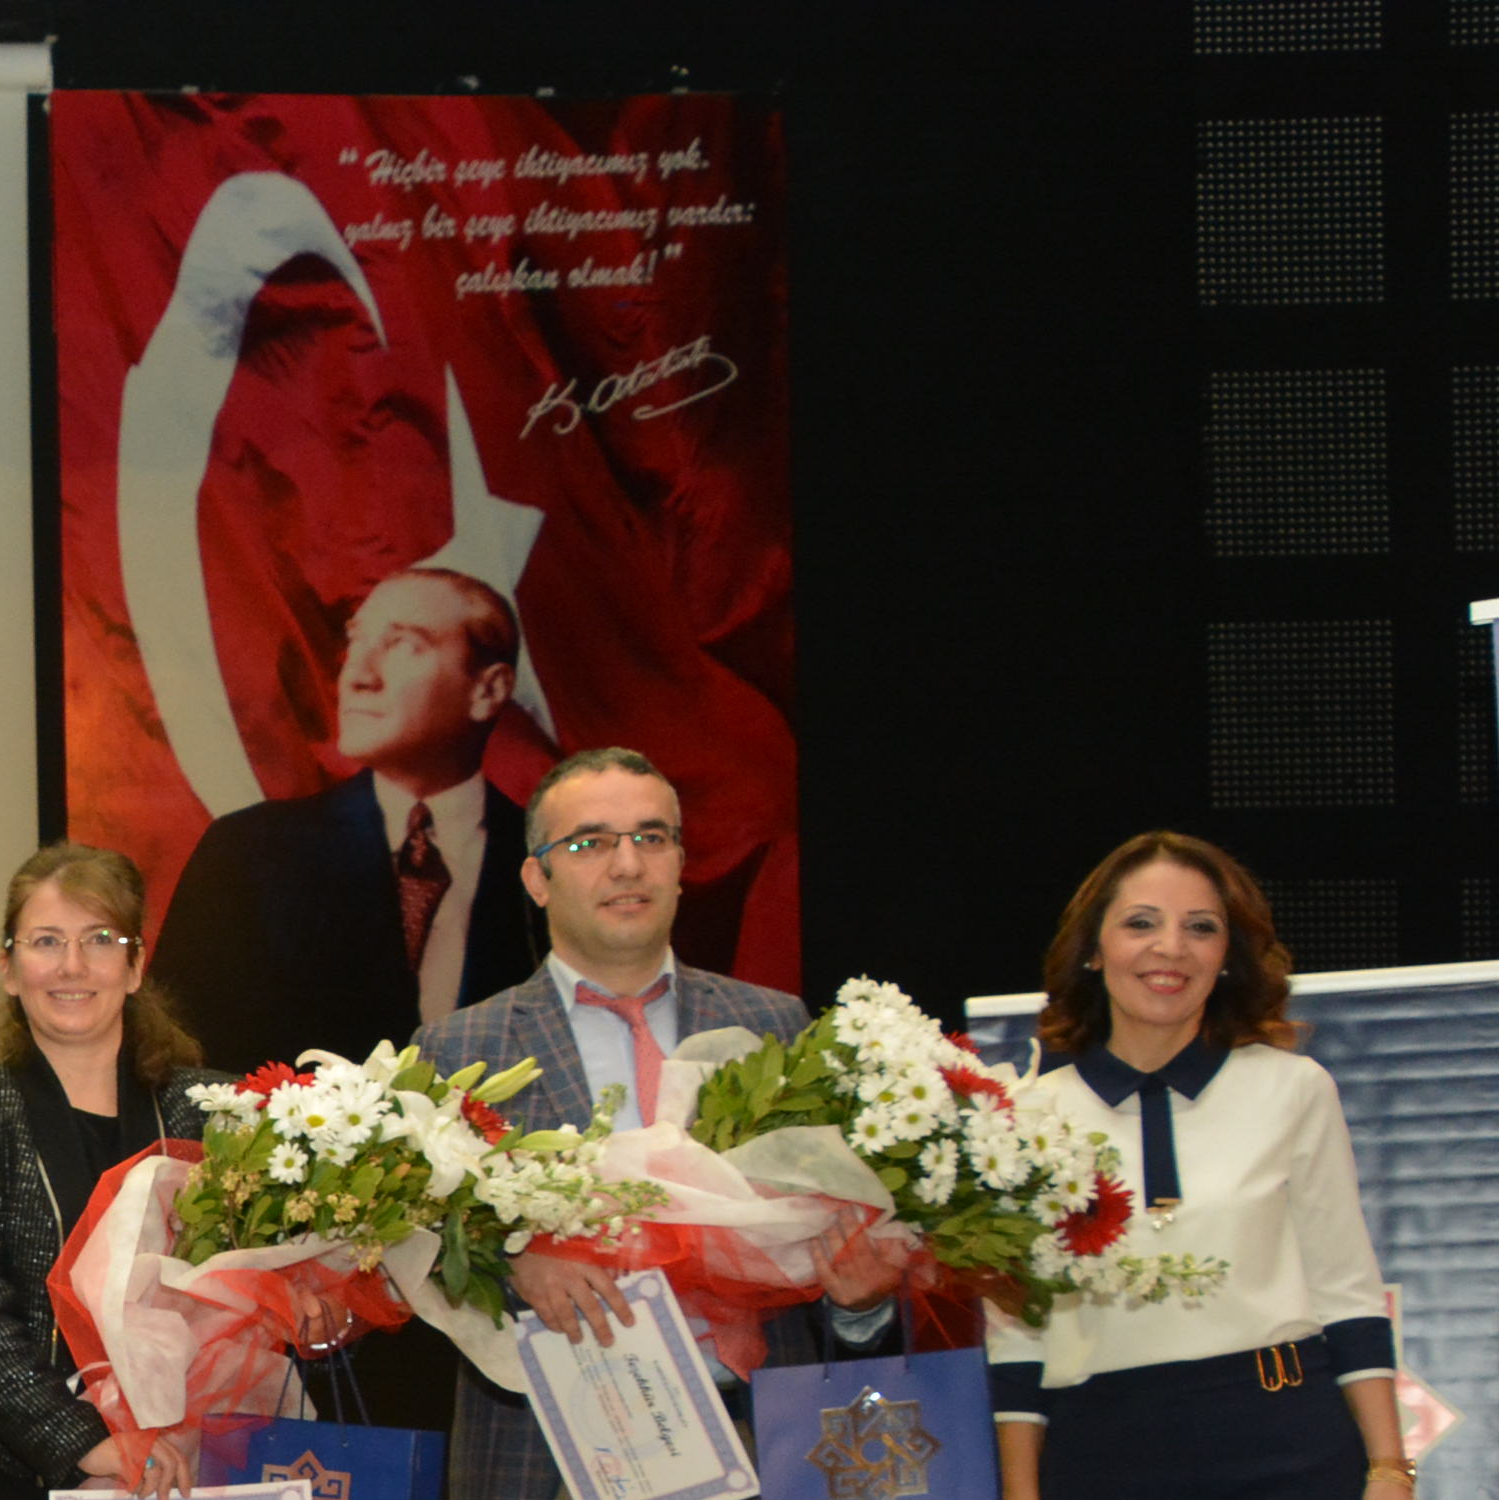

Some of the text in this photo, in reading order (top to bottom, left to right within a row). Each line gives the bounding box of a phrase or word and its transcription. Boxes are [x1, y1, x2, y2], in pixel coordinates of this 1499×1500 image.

[453, 157, 507, 190] şeye
[422, 204, 457, 239] bir
[463, 213, 516, 244] şeye
